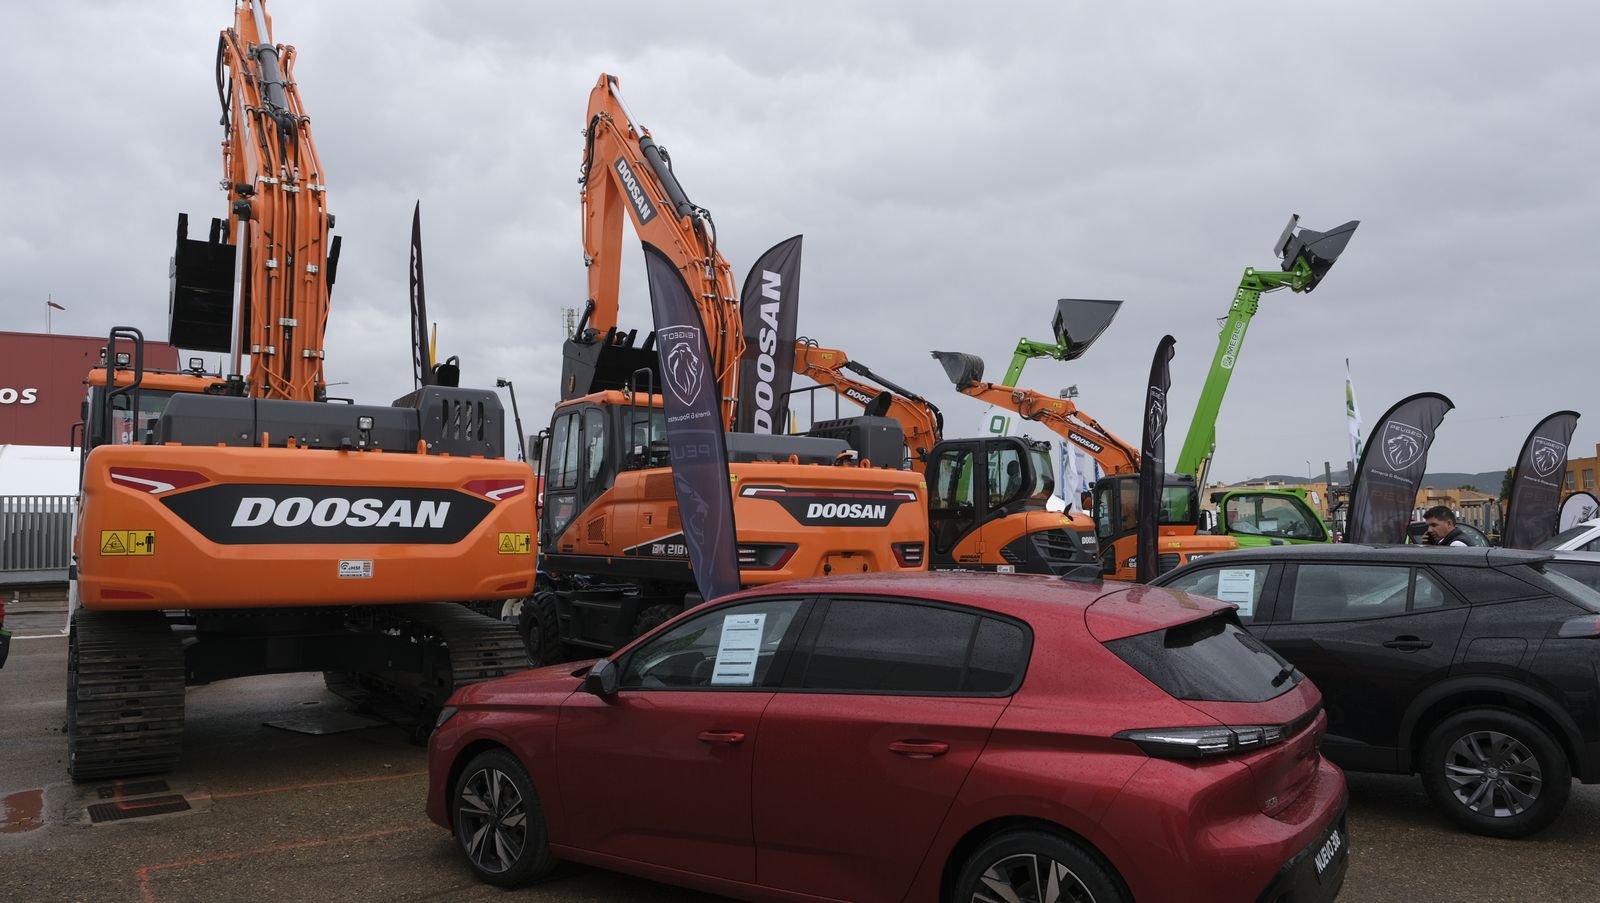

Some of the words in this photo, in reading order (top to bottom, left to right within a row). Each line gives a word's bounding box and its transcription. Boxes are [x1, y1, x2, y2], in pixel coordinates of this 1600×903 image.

[617, 159, 651, 220] DOOSAN
[754, 269, 782, 435] DOOSAN
[1227, 321, 1243, 355] MERLO
[846, 388, 872, 404] DOOS
[1070, 433, 1101, 452] DOOSAN
[230, 496, 451, 529] DOOSAN
[806, 503, 886, 519] DOOSAN
[1314, 840, 1335, 874] NUEVO
[1330, 829, 1341, 852] 308
